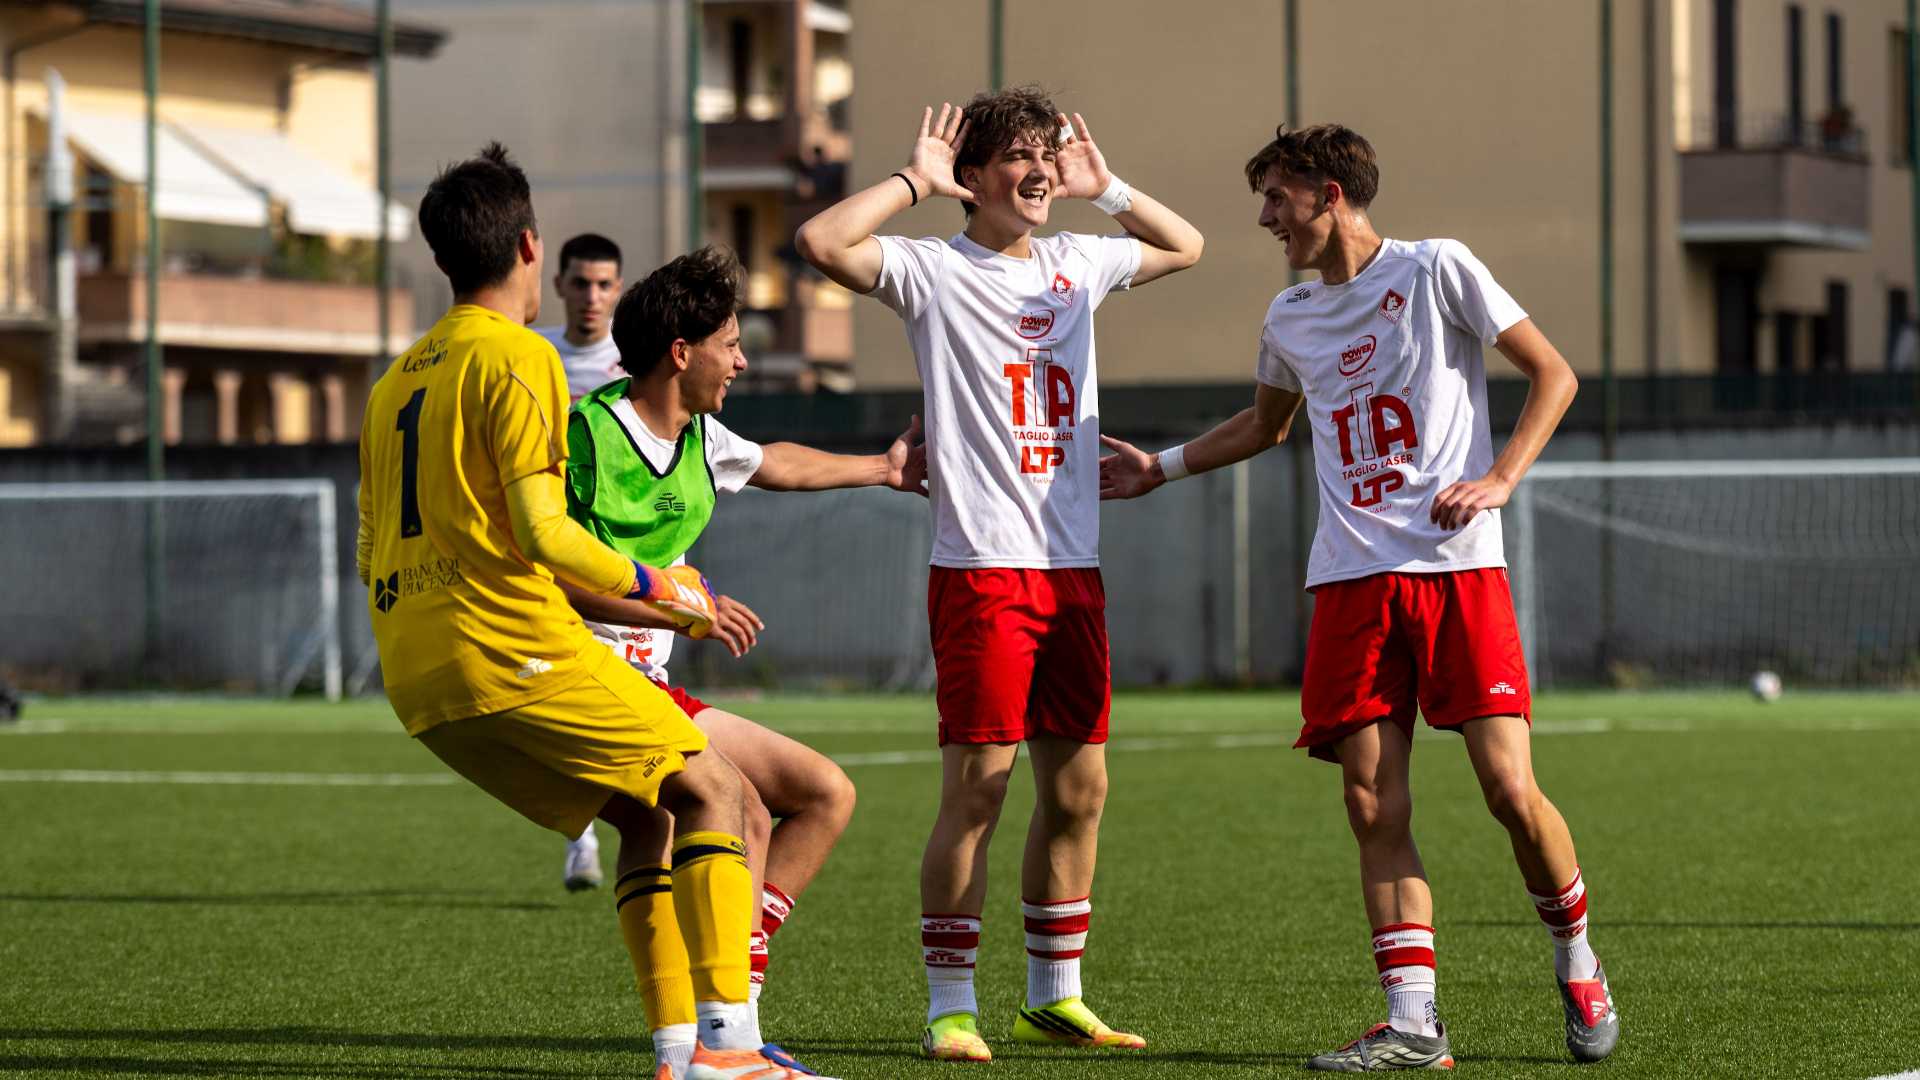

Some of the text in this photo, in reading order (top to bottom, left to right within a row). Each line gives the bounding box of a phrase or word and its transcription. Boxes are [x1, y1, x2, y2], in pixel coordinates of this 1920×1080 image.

[1021, 316, 1050, 327] POWER
[1341, 343, 1372, 361] POWER
[1013, 431, 1075, 441] TAGLIO LASER
[396, 387, 428, 539] 1
[1020, 446, 1065, 474] LTP
[1342, 453, 1415, 480] TAGLIO LASER
[1350, 470, 1404, 508] LTP
[402, 570, 466, 598] PIACENZA
[403, 559, 443, 582] BANCA
